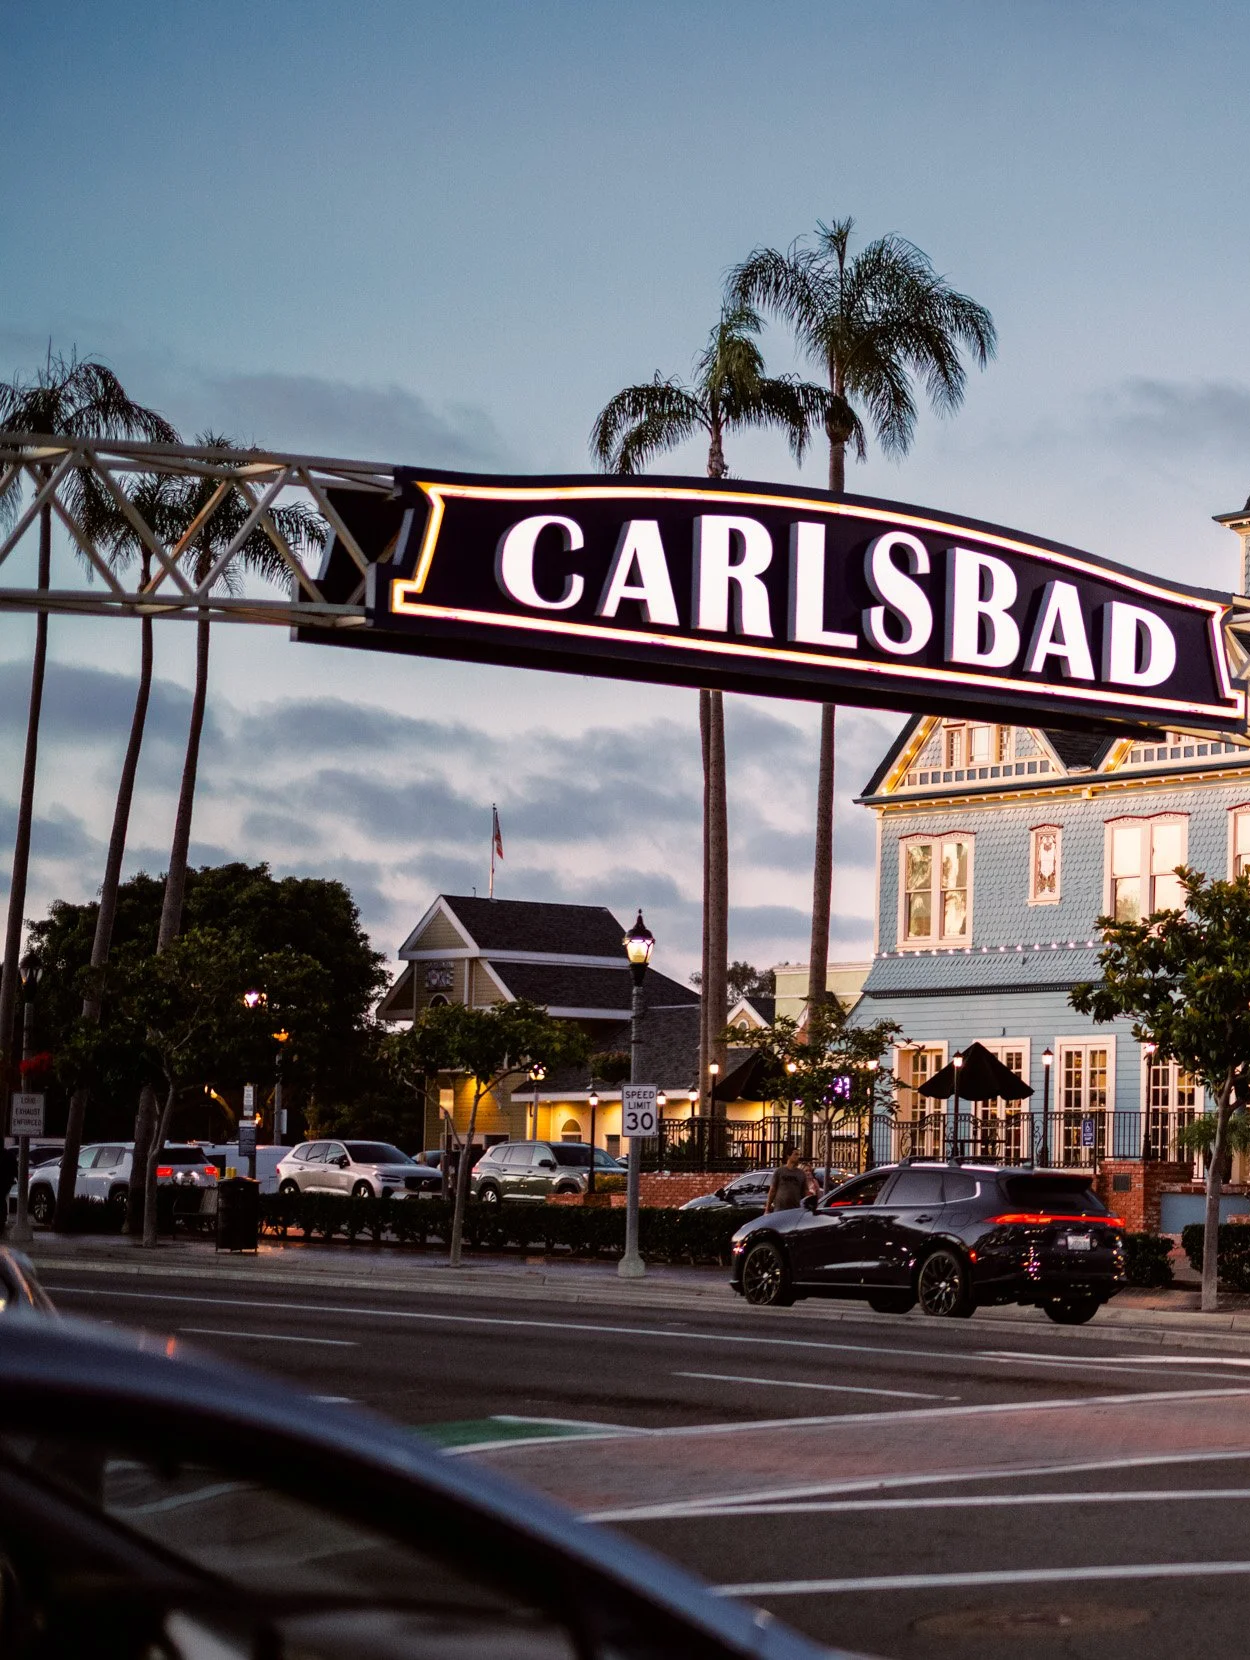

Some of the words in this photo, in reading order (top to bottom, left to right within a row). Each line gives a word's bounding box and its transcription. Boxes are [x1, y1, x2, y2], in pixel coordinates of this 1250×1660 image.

[494, 513, 1178, 688] CARLSBAD
[625, 1090, 655, 1099] SPEED
[628, 1101, 652, 1110] LIMIT
[626, 1112, 654, 1131] 30
